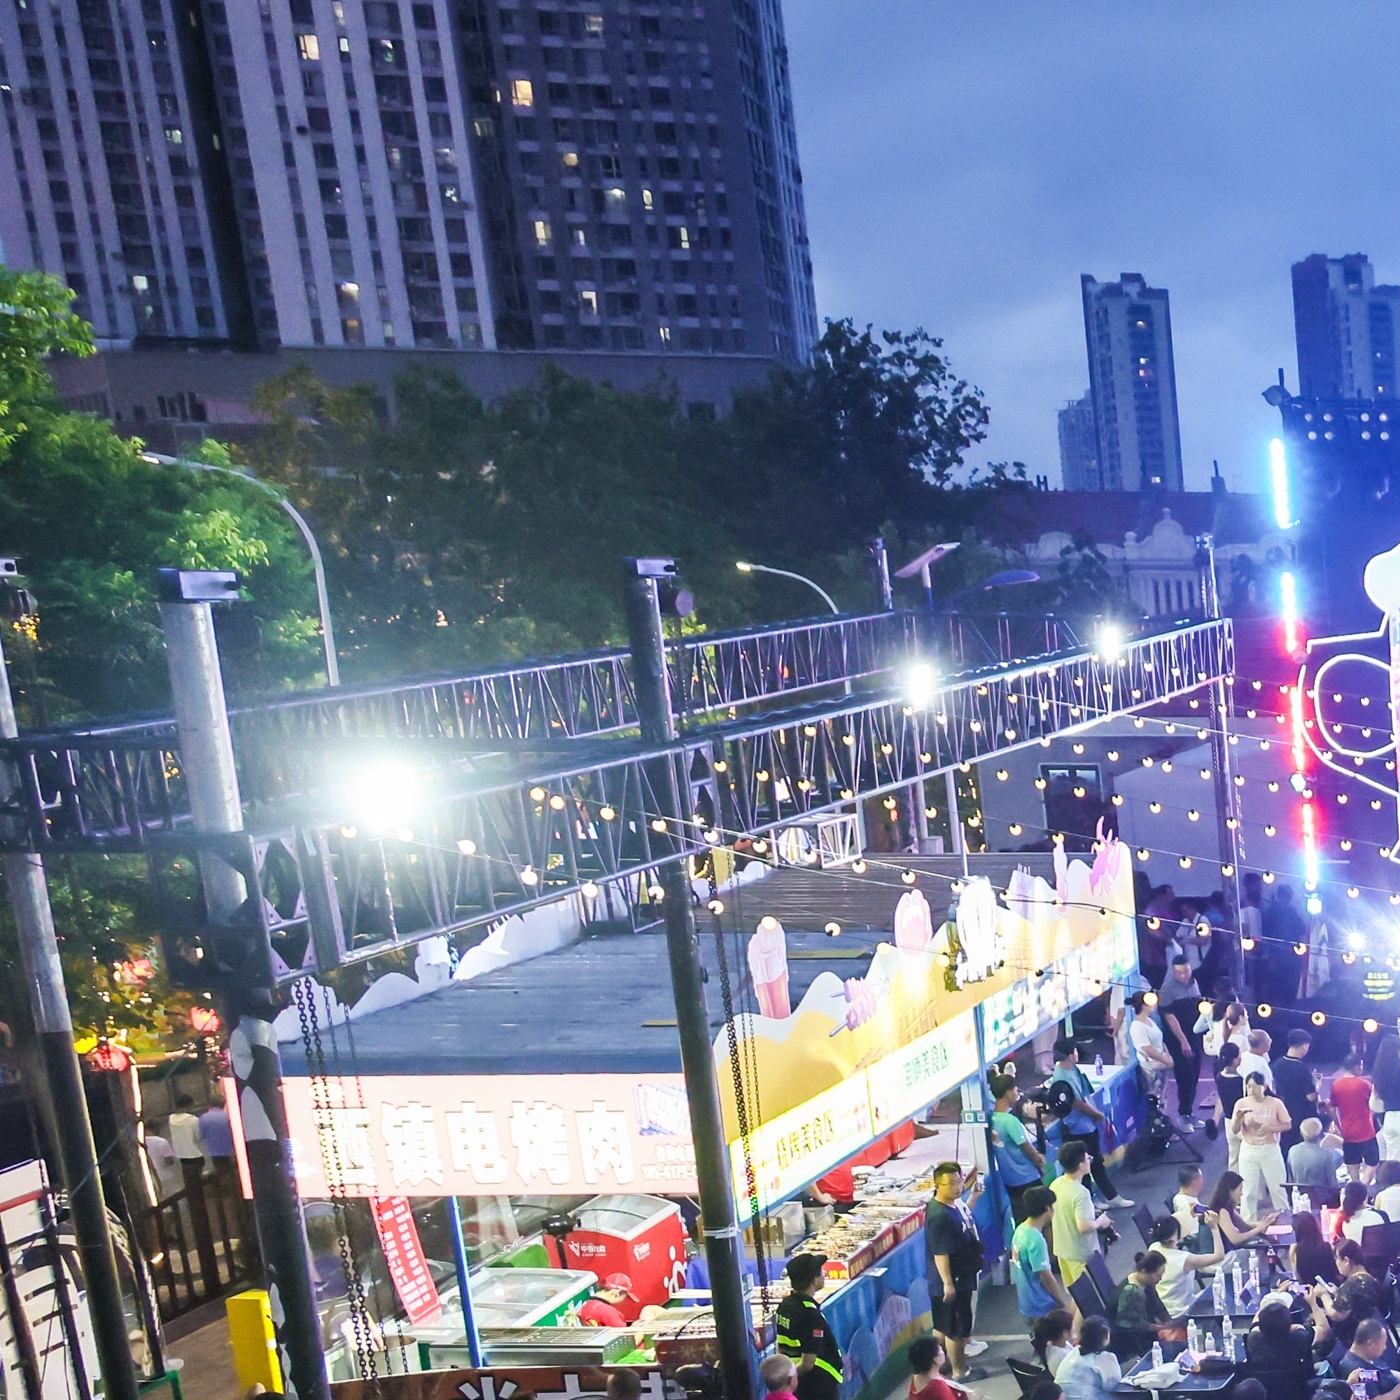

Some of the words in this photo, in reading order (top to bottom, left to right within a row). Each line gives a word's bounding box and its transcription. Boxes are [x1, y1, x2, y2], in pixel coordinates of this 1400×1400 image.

[776, 1109, 836, 1172] 烧烤美食区
